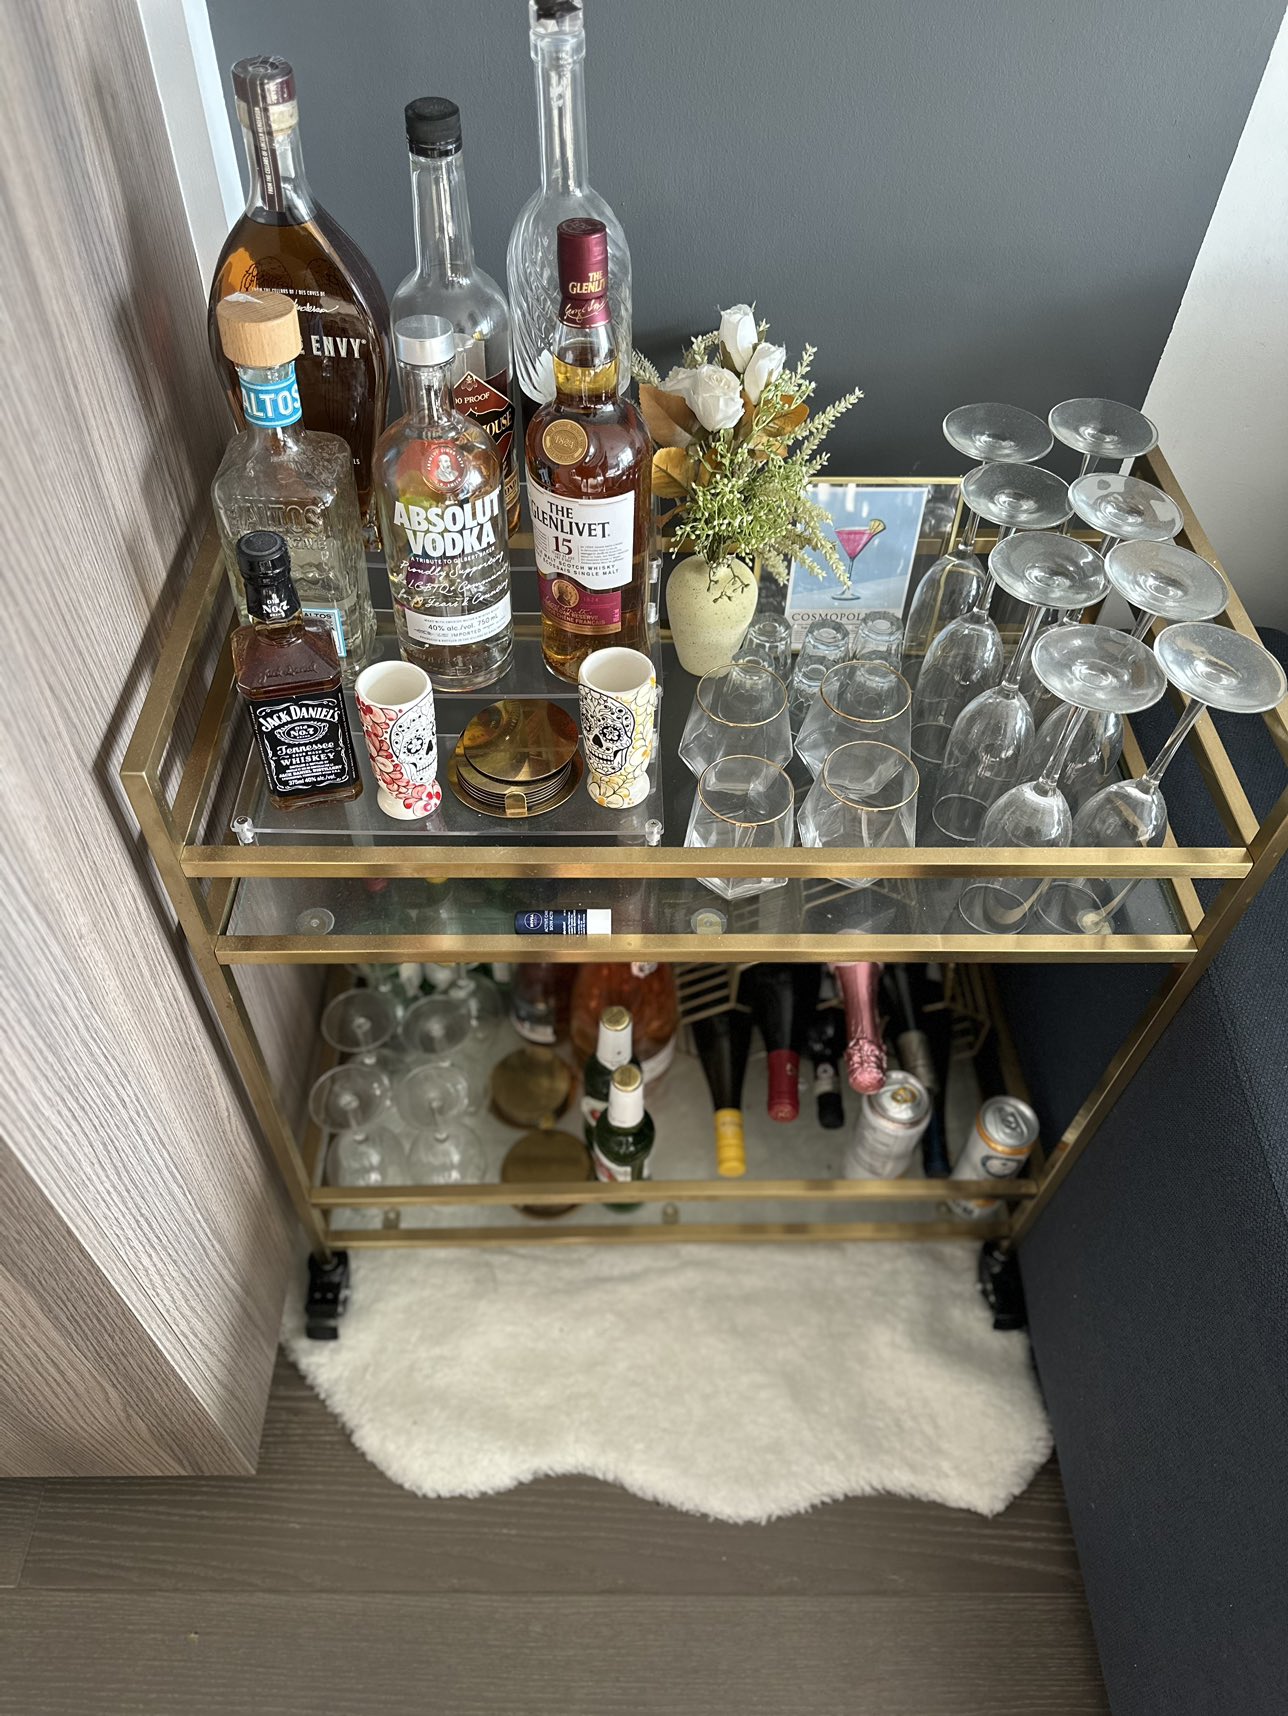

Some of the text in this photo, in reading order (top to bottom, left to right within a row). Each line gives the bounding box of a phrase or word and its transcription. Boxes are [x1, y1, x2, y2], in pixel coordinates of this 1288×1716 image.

[588, 271, 603, 282] THE
[242, 383, 300, 418] ALTOS
[464, 392, 490, 404] PROOF
[394, 485, 500, 533] ABSOLUT
[547, 500, 573, 520] THE
[404, 520, 496, 558] VODKA
[552, 536, 572, 556] 15
[454, 554, 478, 563] GILBERT
[480, 546, 495, 558] BAKER
[400, 552, 504, 580] Proudly Supporting
[559, 560, 584, 570] SCOTCH
[458, 561, 509, 592] Community
[425, 596, 461, 608] Years
[478, 616, 490, 626] 750
[451, 628, 481, 638] IMPORTED
[258, 705, 341, 732] JACK DANIEL'S
[276, 742, 334, 756] Tennessee
[280, 752, 336, 766] WHISKEY
